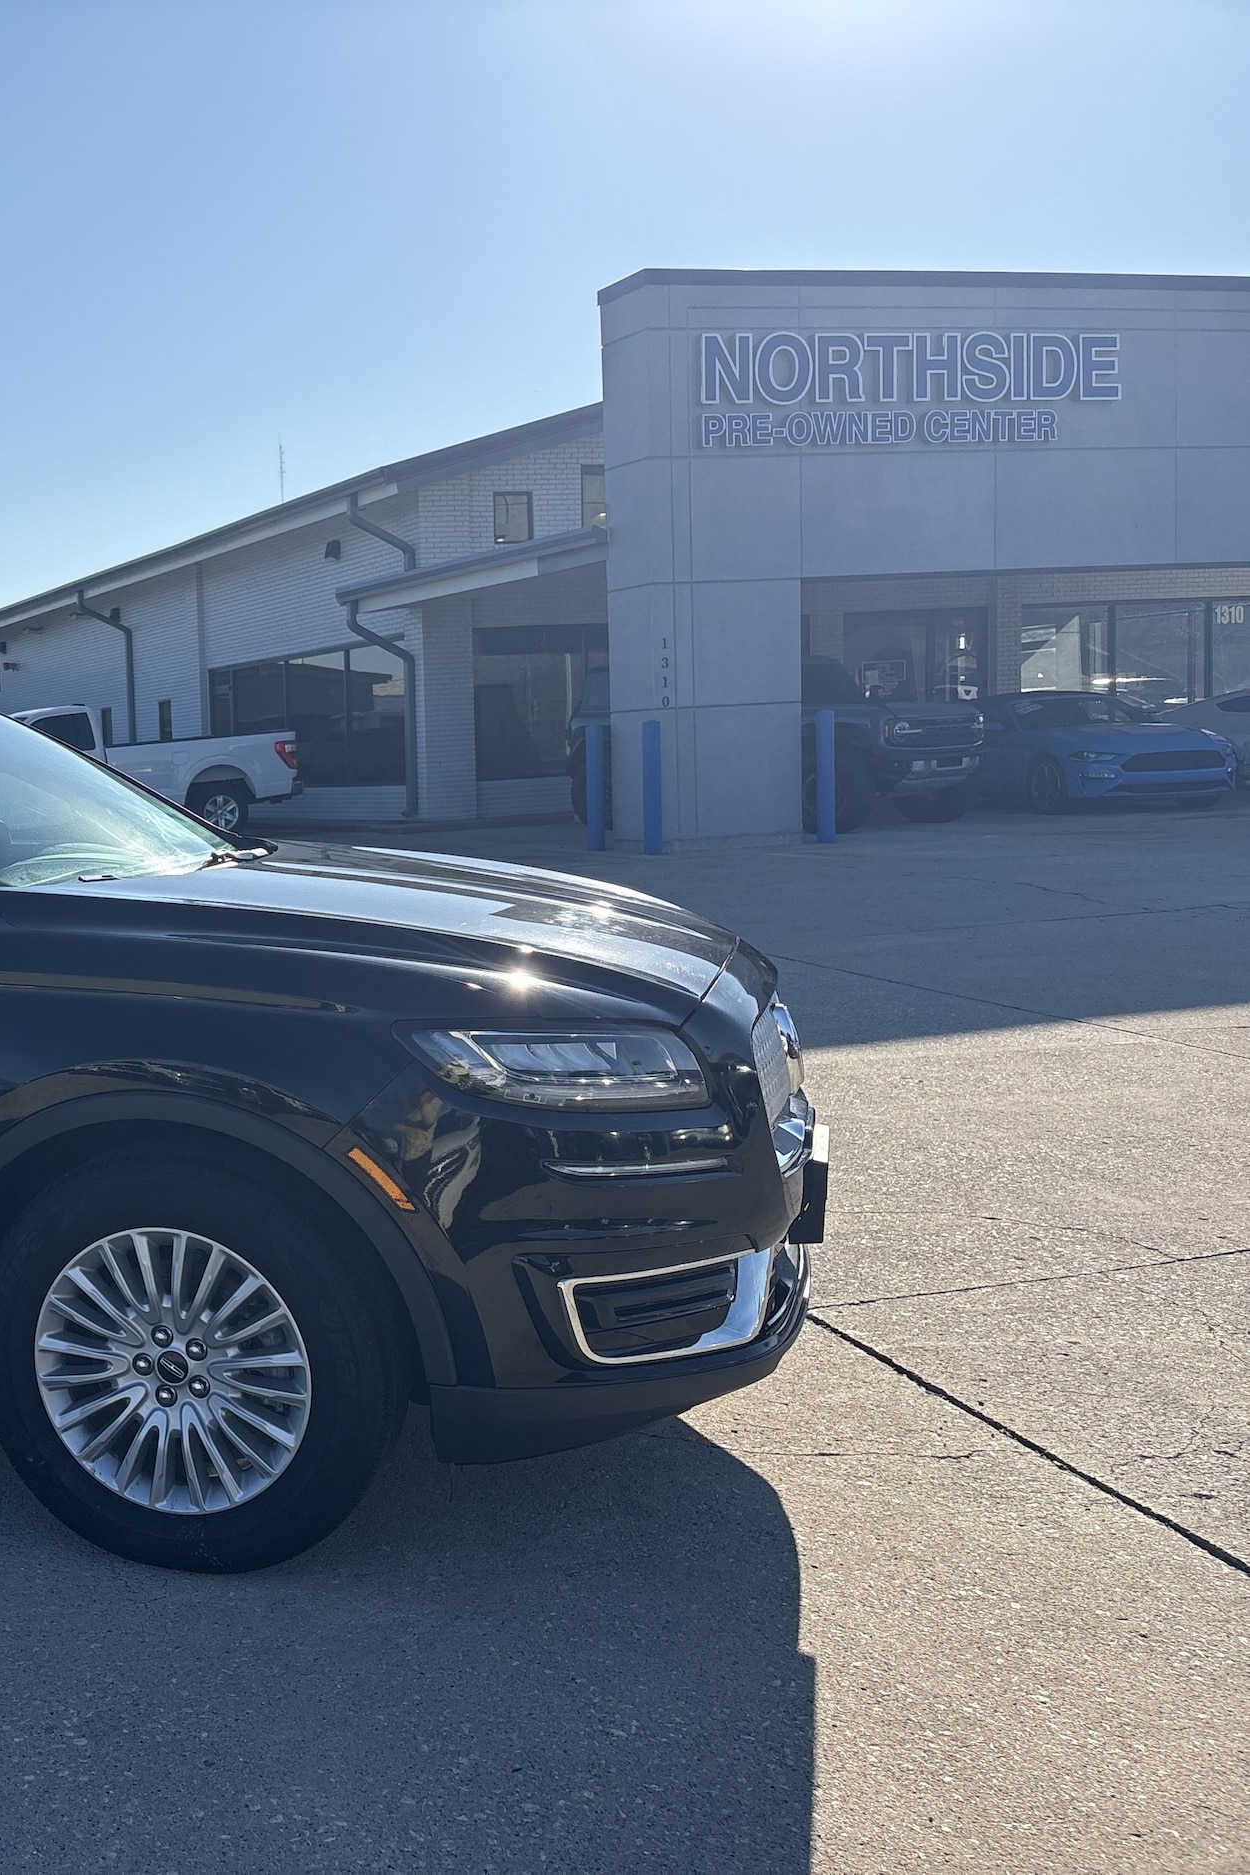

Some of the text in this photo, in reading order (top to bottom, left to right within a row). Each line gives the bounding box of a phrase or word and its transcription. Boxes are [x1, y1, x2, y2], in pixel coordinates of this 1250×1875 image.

[701, 331, 1122, 405] NORTHSIDE
[702, 409, 1058, 447] PRE-OWNED CENTER
[1215, 605, 1244, 624] 1310
[661, 637, 670, 707] 1310
